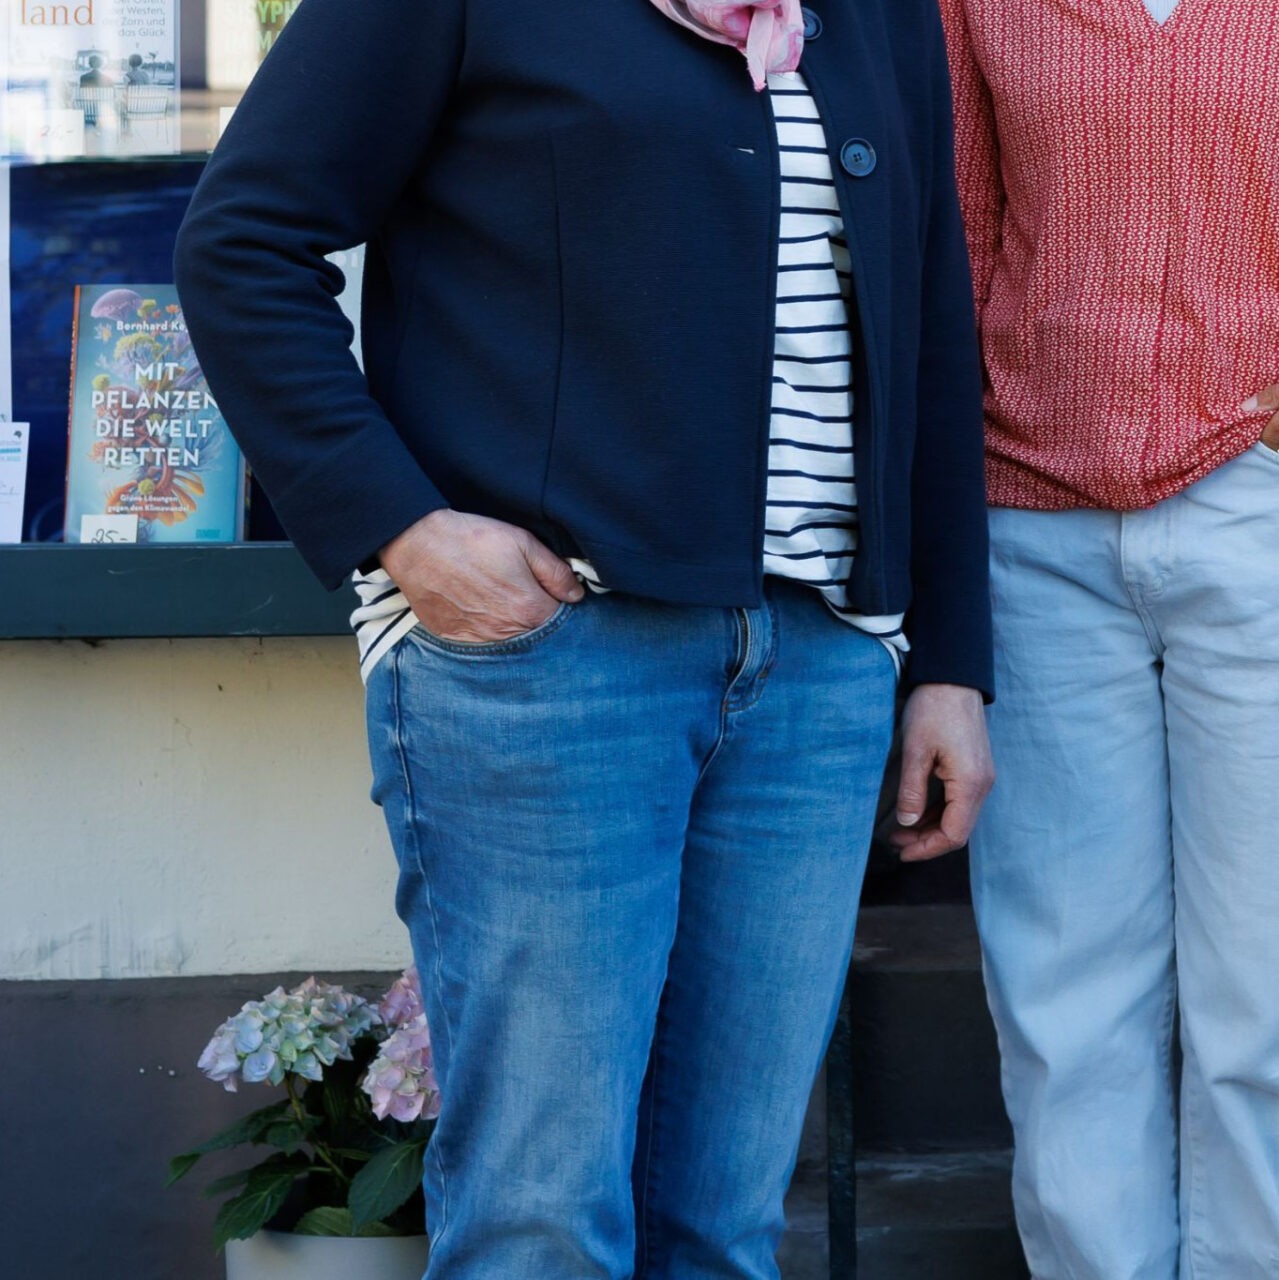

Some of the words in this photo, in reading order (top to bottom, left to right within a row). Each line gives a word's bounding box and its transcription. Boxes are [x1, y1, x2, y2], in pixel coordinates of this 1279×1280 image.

[120, 18, 144, 27] Zorn
[146, 17, 166, 26] und
[118, 27, 136, 37] das
[138, 27, 165, 38] Glück
[116, 320, 168, 331] Bernhard
[135, 362, 179, 381] MIT
[91, 389, 219, 410] PFLANZEN
[95, 418, 135, 438] DIE
[145, 418, 213, 438] WELT
[103, 447, 200, 467] RETTEN
